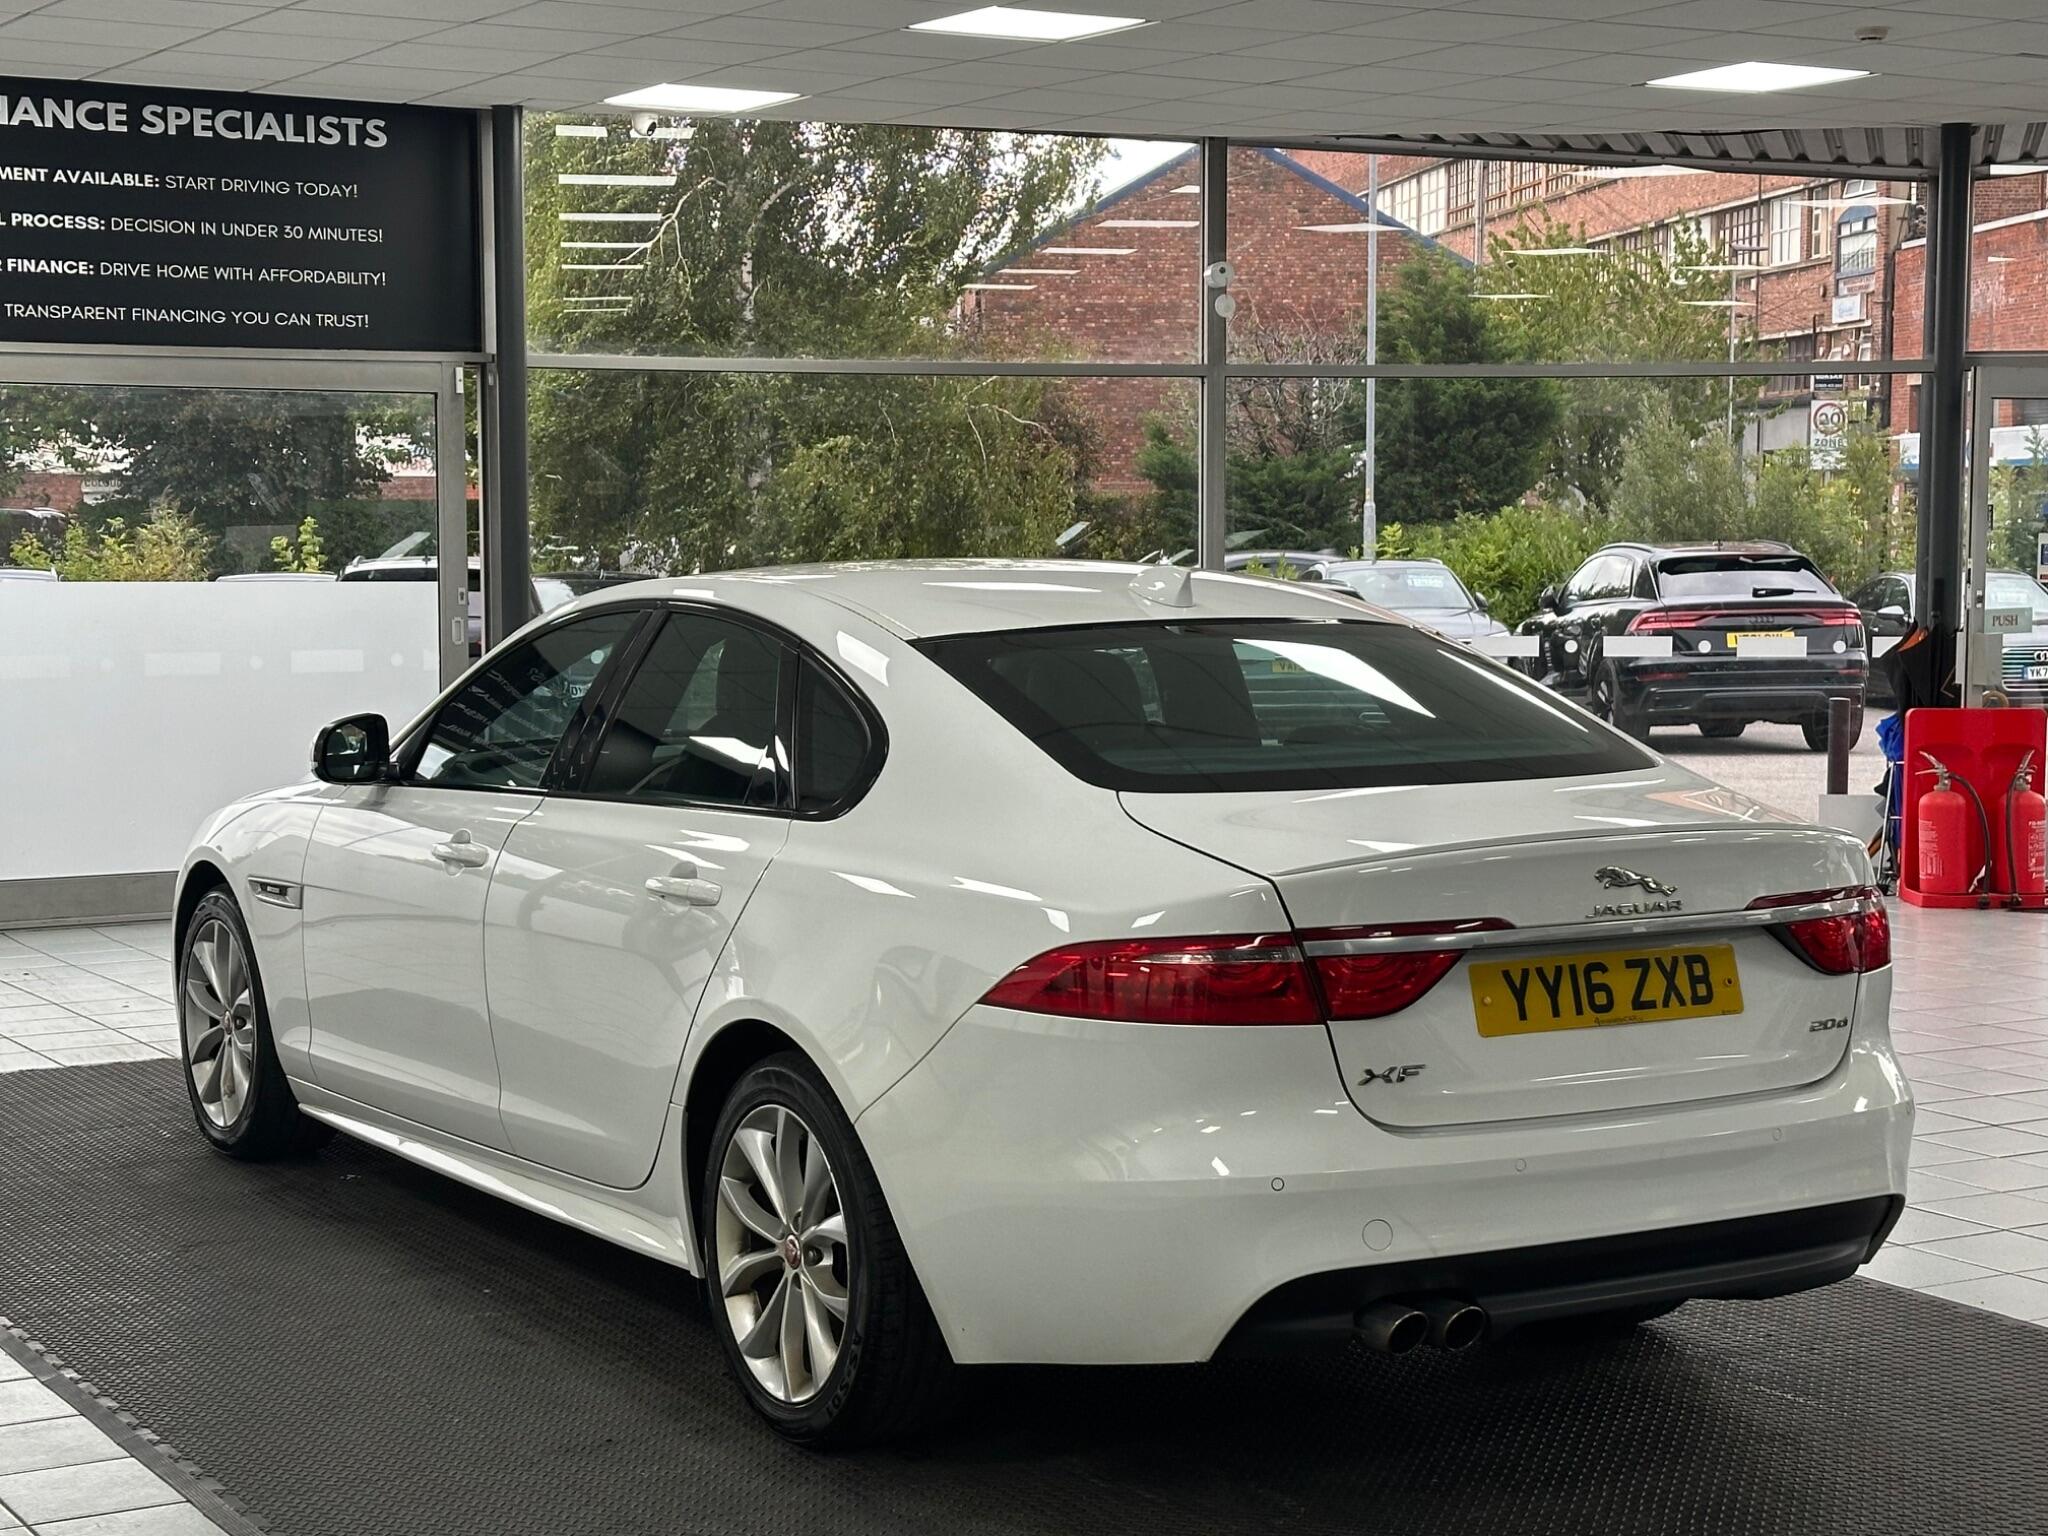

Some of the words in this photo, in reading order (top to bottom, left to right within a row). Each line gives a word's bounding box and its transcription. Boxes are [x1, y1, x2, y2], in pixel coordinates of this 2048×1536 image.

[0, 95, 128, 133] ANCE
[140, 105, 388, 148] SPECIALISTS
[52, 169, 160, 188] AVAILABLE:
[165, 175, 216, 191] START
[221, 178, 291, 195] DRIVING
[295, 181, 358, 198] TODAY!
[11, 212, 106, 231] PROCESS:
[110, 217, 196, 235] DECISION
[200, 221, 217, 236] IN
[221, 222, 279, 239] UNDER
[283, 225, 304, 240] 30
[307, 226, 383, 243] MINUTES!
[6, 258, 95, 276] FINANCE:
[100, 261, 151, 278] DRIVE
[156, 264, 209, 280] HOME
[213, 266, 253, 281] WITH
[258, 268, 386, 287] AFFORDABILITY!
[4, 303, 127, 321] TRANSPARENT
[131, 307, 227, 324] FINANCING
[230, 311, 270, 325] YOU
[274, 312, 311, 326] CAN
[315, 313, 369, 329] TRUST!
[1992, 614, 2019, 627] PUSH
[2029, 667, 2048, 677] YK7
[1584, 899, 1683, 920] JAGUAR
[1501, 959, 1616, 1022] YY16
[1624, 953, 1715, 1012] ZXB
[1808, 1016, 1848, 1033] 20d
[1357, 1063, 1427, 1087] XF
